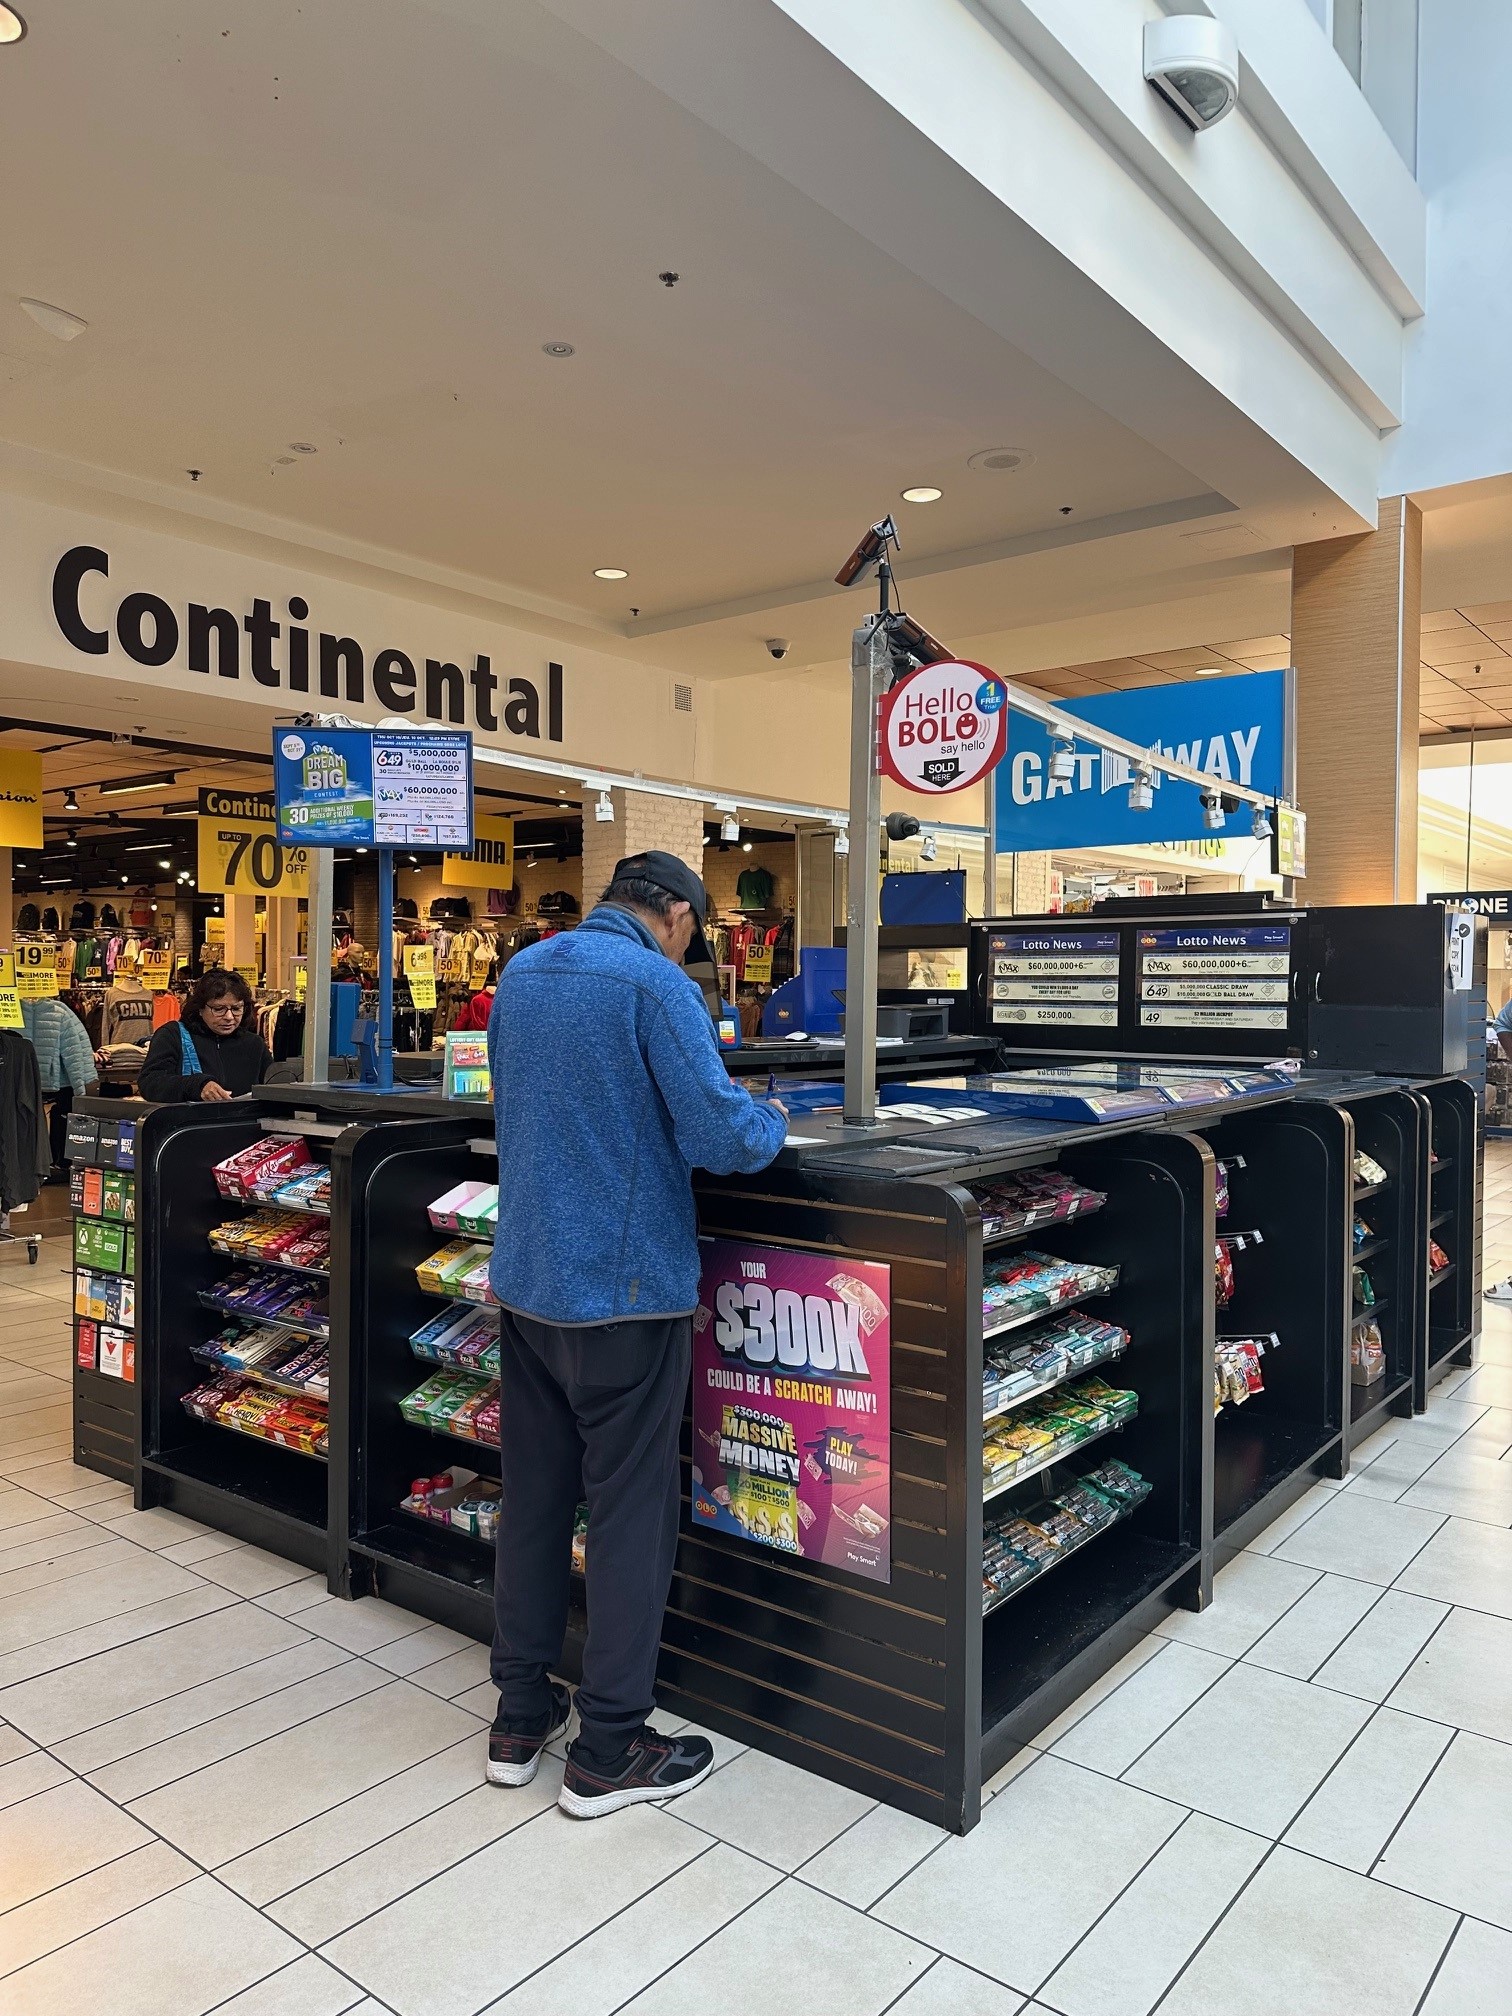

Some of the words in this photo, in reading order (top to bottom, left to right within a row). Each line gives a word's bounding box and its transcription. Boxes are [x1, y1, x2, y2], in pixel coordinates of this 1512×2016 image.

[52, 545, 563, 743] Continental
[905, 687, 973, 718] Hello
[980, 696, 1001, 705] FREE
[898, 713, 979, 748] BOLO
[409, 749, 458, 757] $5,000,000
[941, 744, 959, 756] say
[961, 740, 985, 752] hello
[307, 754, 343, 770] DREAM
[928, 762, 955, 774] SOLD
[308, 768, 343, 790] BIG
[932, 773, 951, 782] HERE
[378, 789, 403, 801] MAX
[404, 787, 458, 795] $60,000,000
[289, 807, 309, 825] 30
[286, 864, 307, 875] OFF
[1022, 940, 1050, 950] Lotto
[1053, 940, 1082, 950] News
[1177, 936, 1208, 946] Lotto
[1213, 935, 1247, 946] News
[16, 946, 42, 966] 19
[410, 953, 417, 968] 6
[998, 963, 1019, 973] MAX
[1147, 961, 1172, 973] MAX
[1037, 1011, 1072, 1019] $250,000
[1145, 1013, 1160, 1023] 49
[69, 1134, 95, 1142] amazon
[121, 1138, 133, 1146] BEST
[740, 1261, 767, 1279] YOUR
[716, 1281, 870, 1374] $300K
[707, 1368, 743, 1392] COULD
[746, 1374, 760, 1394] BE
[764, 1377, 772, 1396] A
[775, 1378, 832, 1406] SCRATCH
[836, 1388, 878, 1414] AWAY!
[225, 1405, 235, 1414] OH
[733, 1404, 785, 1429] $300,000
[476, 1423, 497, 1433] HALLS
[830, 1437, 853, 1456] PLAY
[719, 1438, 801, 1482] MONEY
[825, 1451, 858, 1475] TODAY!
[752, 1483, 790, 1499] MILLION
[750, 1491, 767, 1502] $100
[772, 1497, 790, 1508] $500
[695, 1501, 718, 1515] OLG
[753, 1532, 774, 1544] $200
[776, 1538, 797, 1551] $300
[848, 1551, 860, 1563] Play
[860, 1556, 877, 1567] Smart
